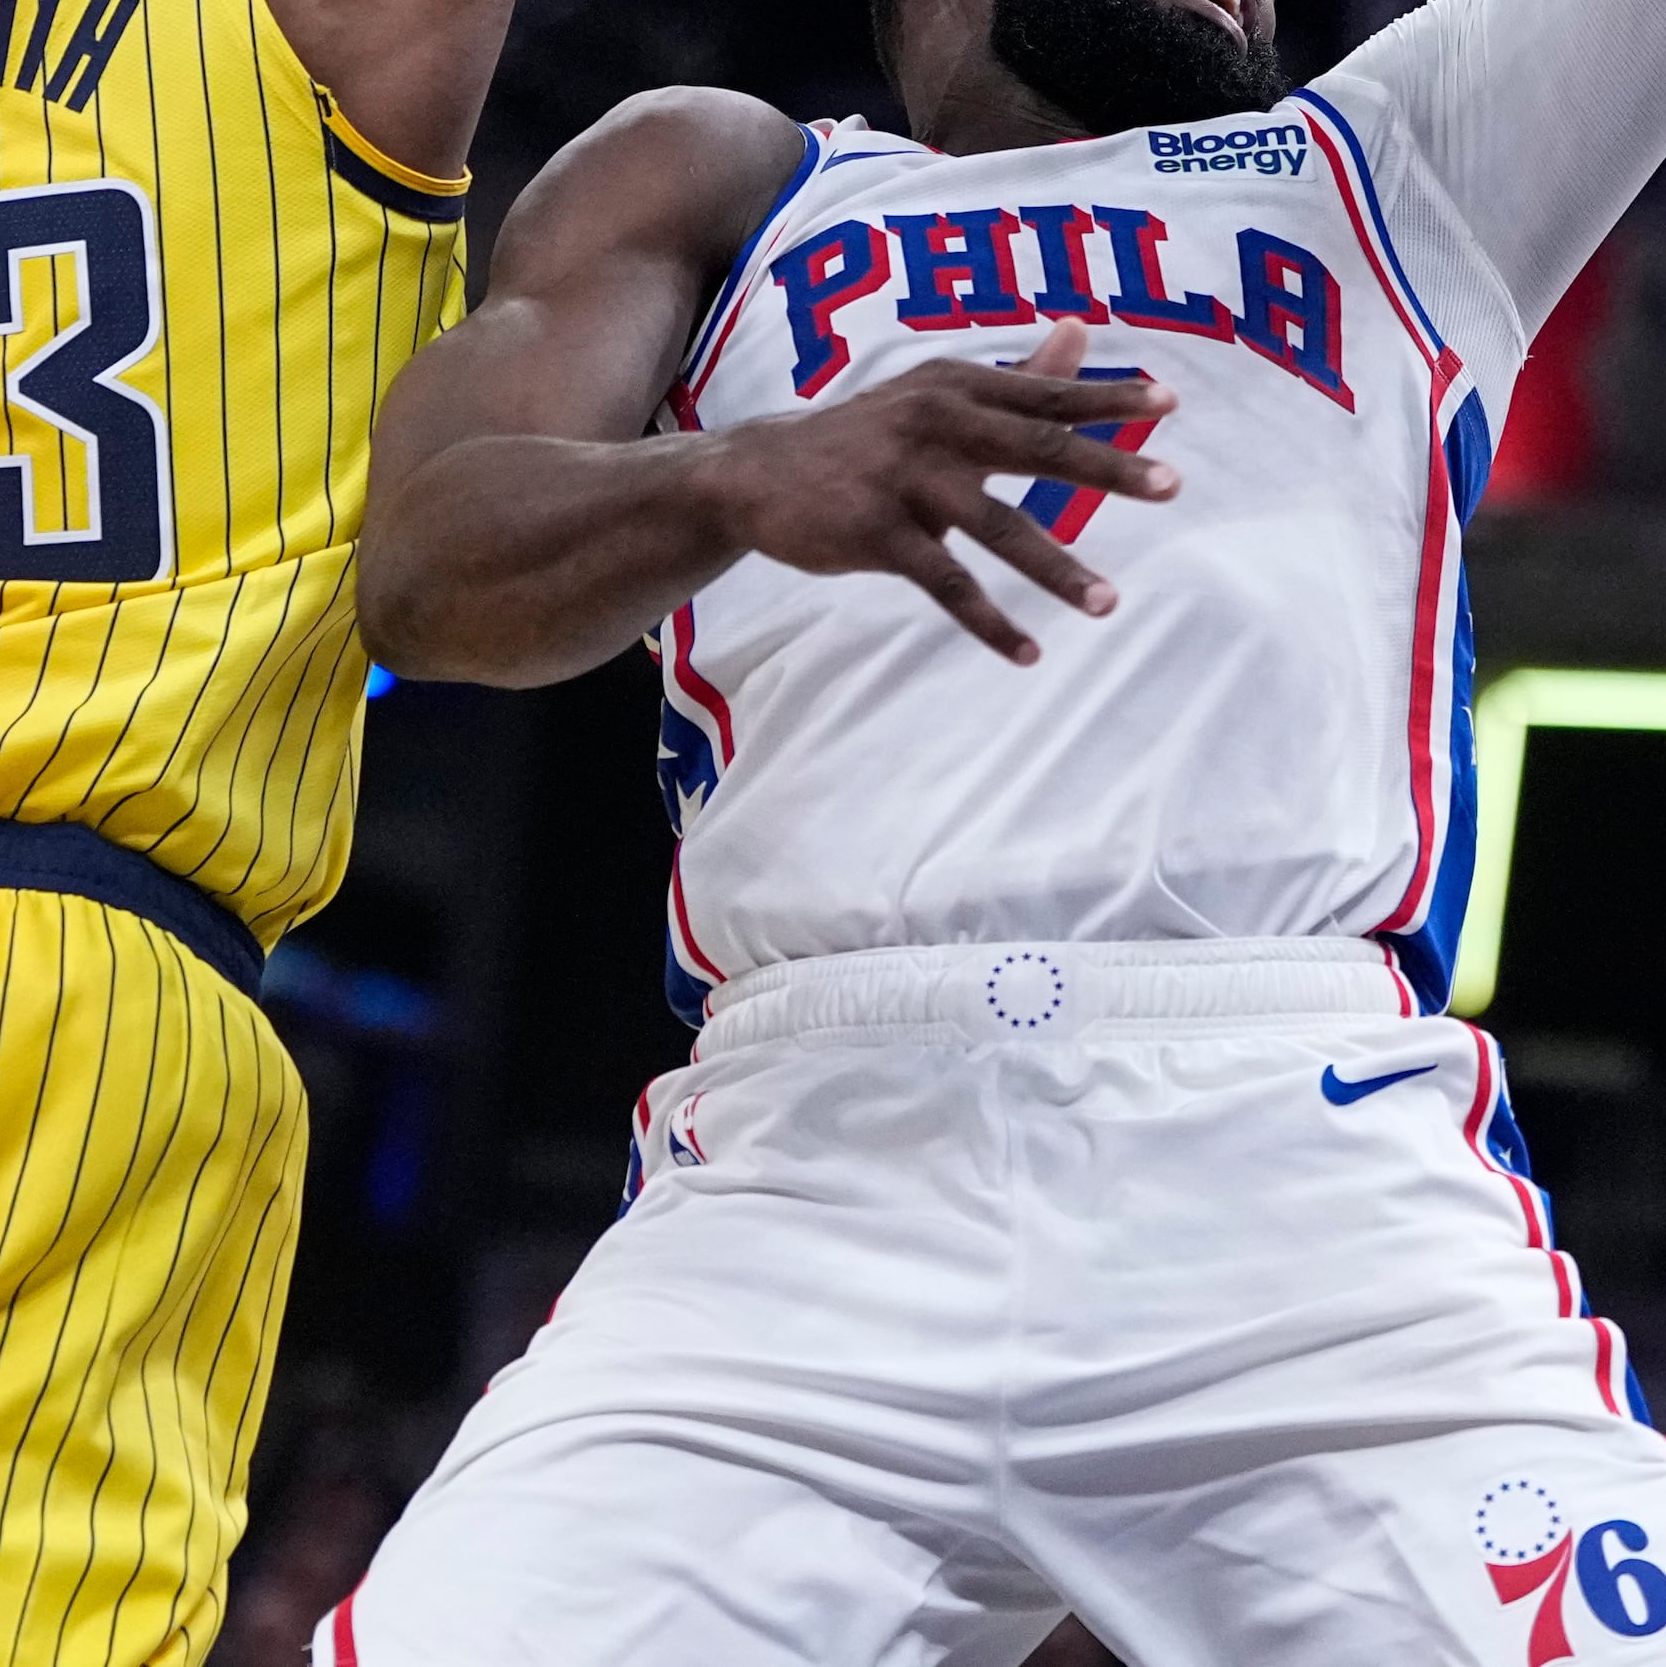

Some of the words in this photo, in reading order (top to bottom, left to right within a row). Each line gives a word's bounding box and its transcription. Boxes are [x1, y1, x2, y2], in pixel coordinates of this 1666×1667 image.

[1148, 124, 1307, 157] Bloom
[1154, 149, 1308, 176] energy
[769, 204, 1355, 414] PHILA
